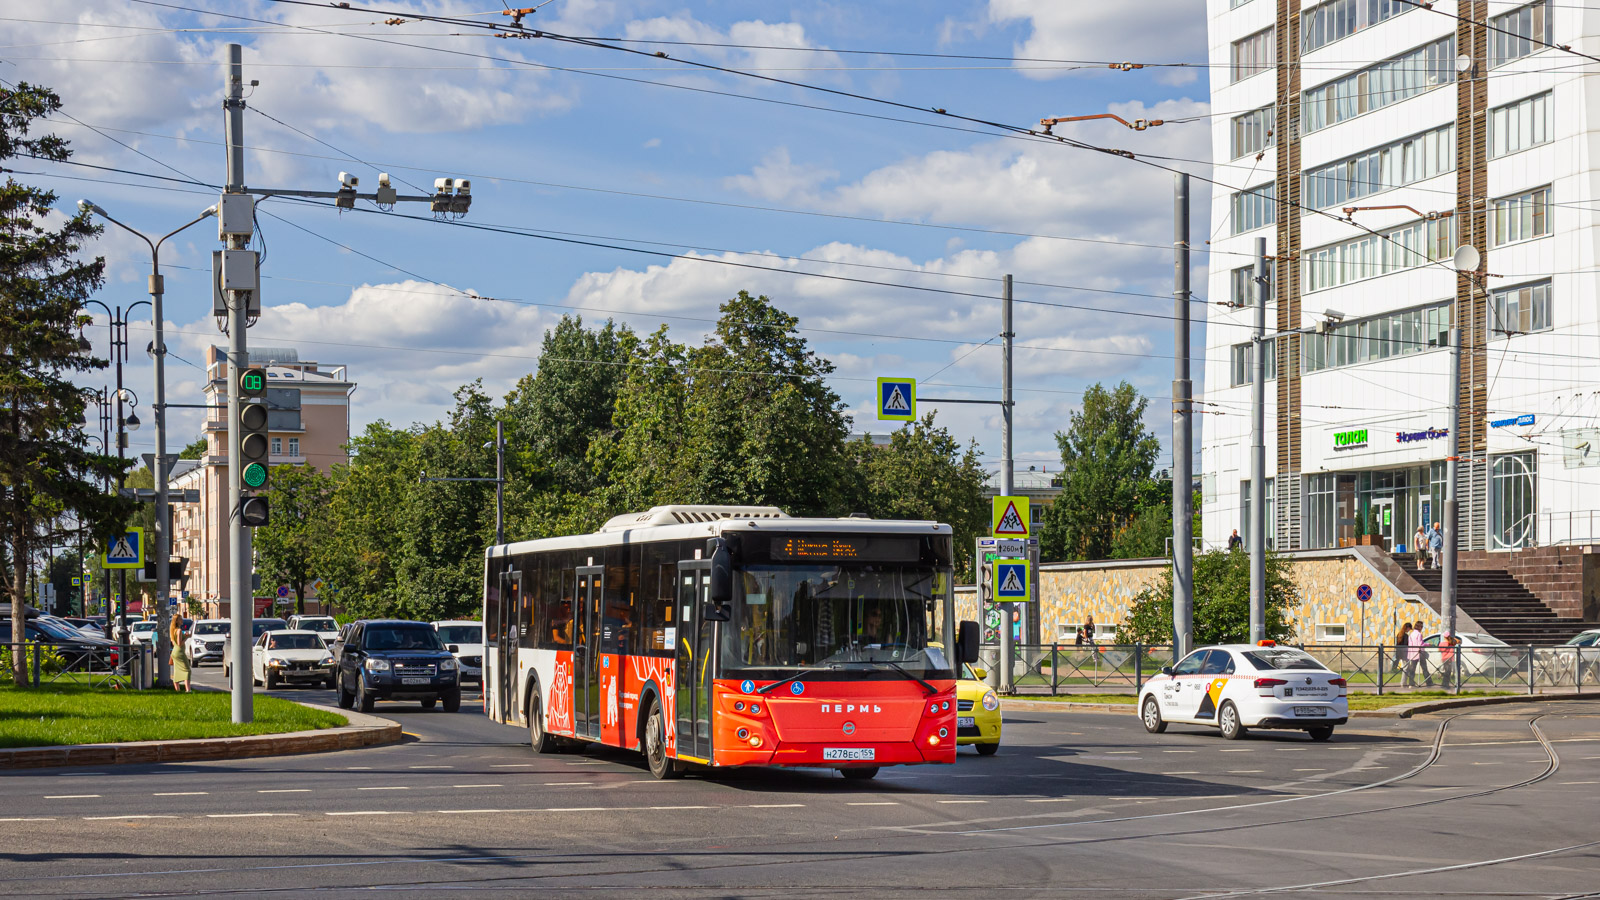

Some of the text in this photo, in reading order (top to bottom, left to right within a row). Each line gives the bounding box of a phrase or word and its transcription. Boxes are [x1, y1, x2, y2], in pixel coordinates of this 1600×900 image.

[245, 375, 262, 390] 08
[821, 704, 882, 713] ПЕРМЬ
[826, 749, 859, 759] Н278ЕС
